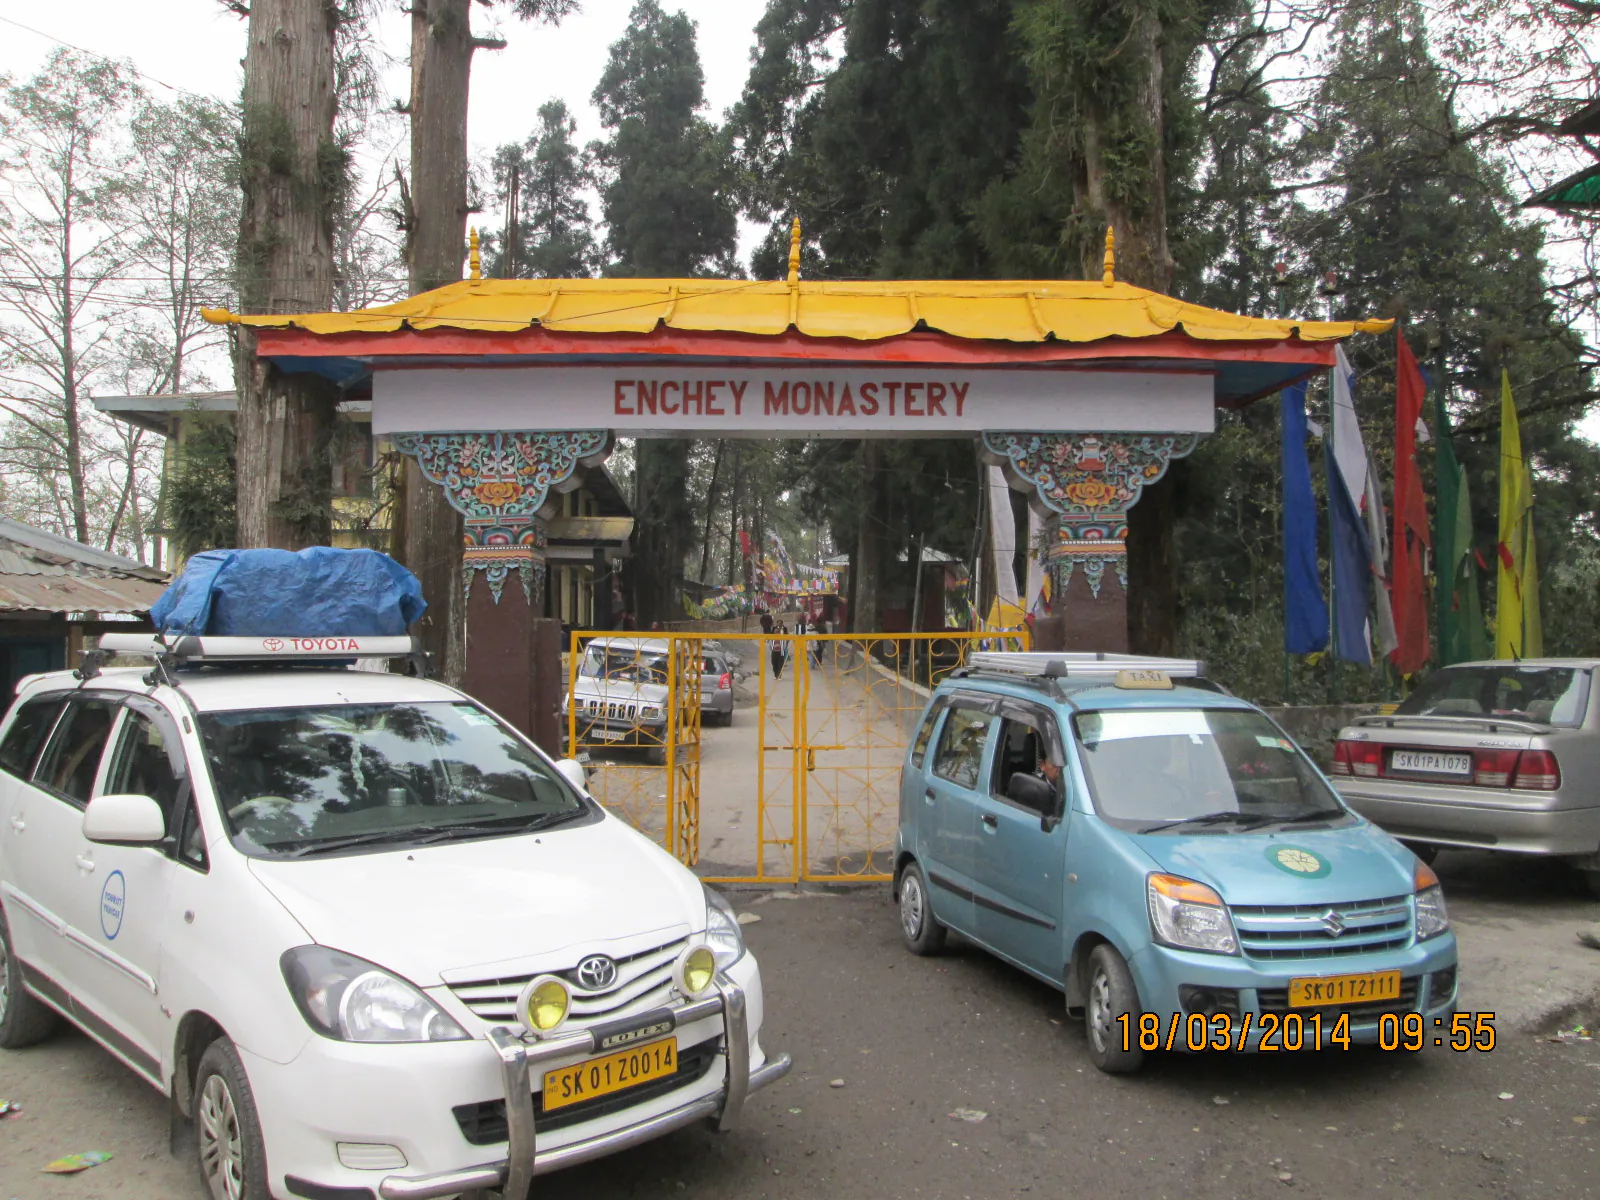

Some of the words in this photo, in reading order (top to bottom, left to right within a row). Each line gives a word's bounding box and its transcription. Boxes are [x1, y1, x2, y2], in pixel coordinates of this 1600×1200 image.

[614, 380, 749, 415] ENCHEY
[764, 381, 970, 416] MONASTERY
[290, 638, 360, 650] TOYOTA
[1129, 672, 1163, 682] TAXI
[1400, 753, 1469, 770] SK01PA1078
